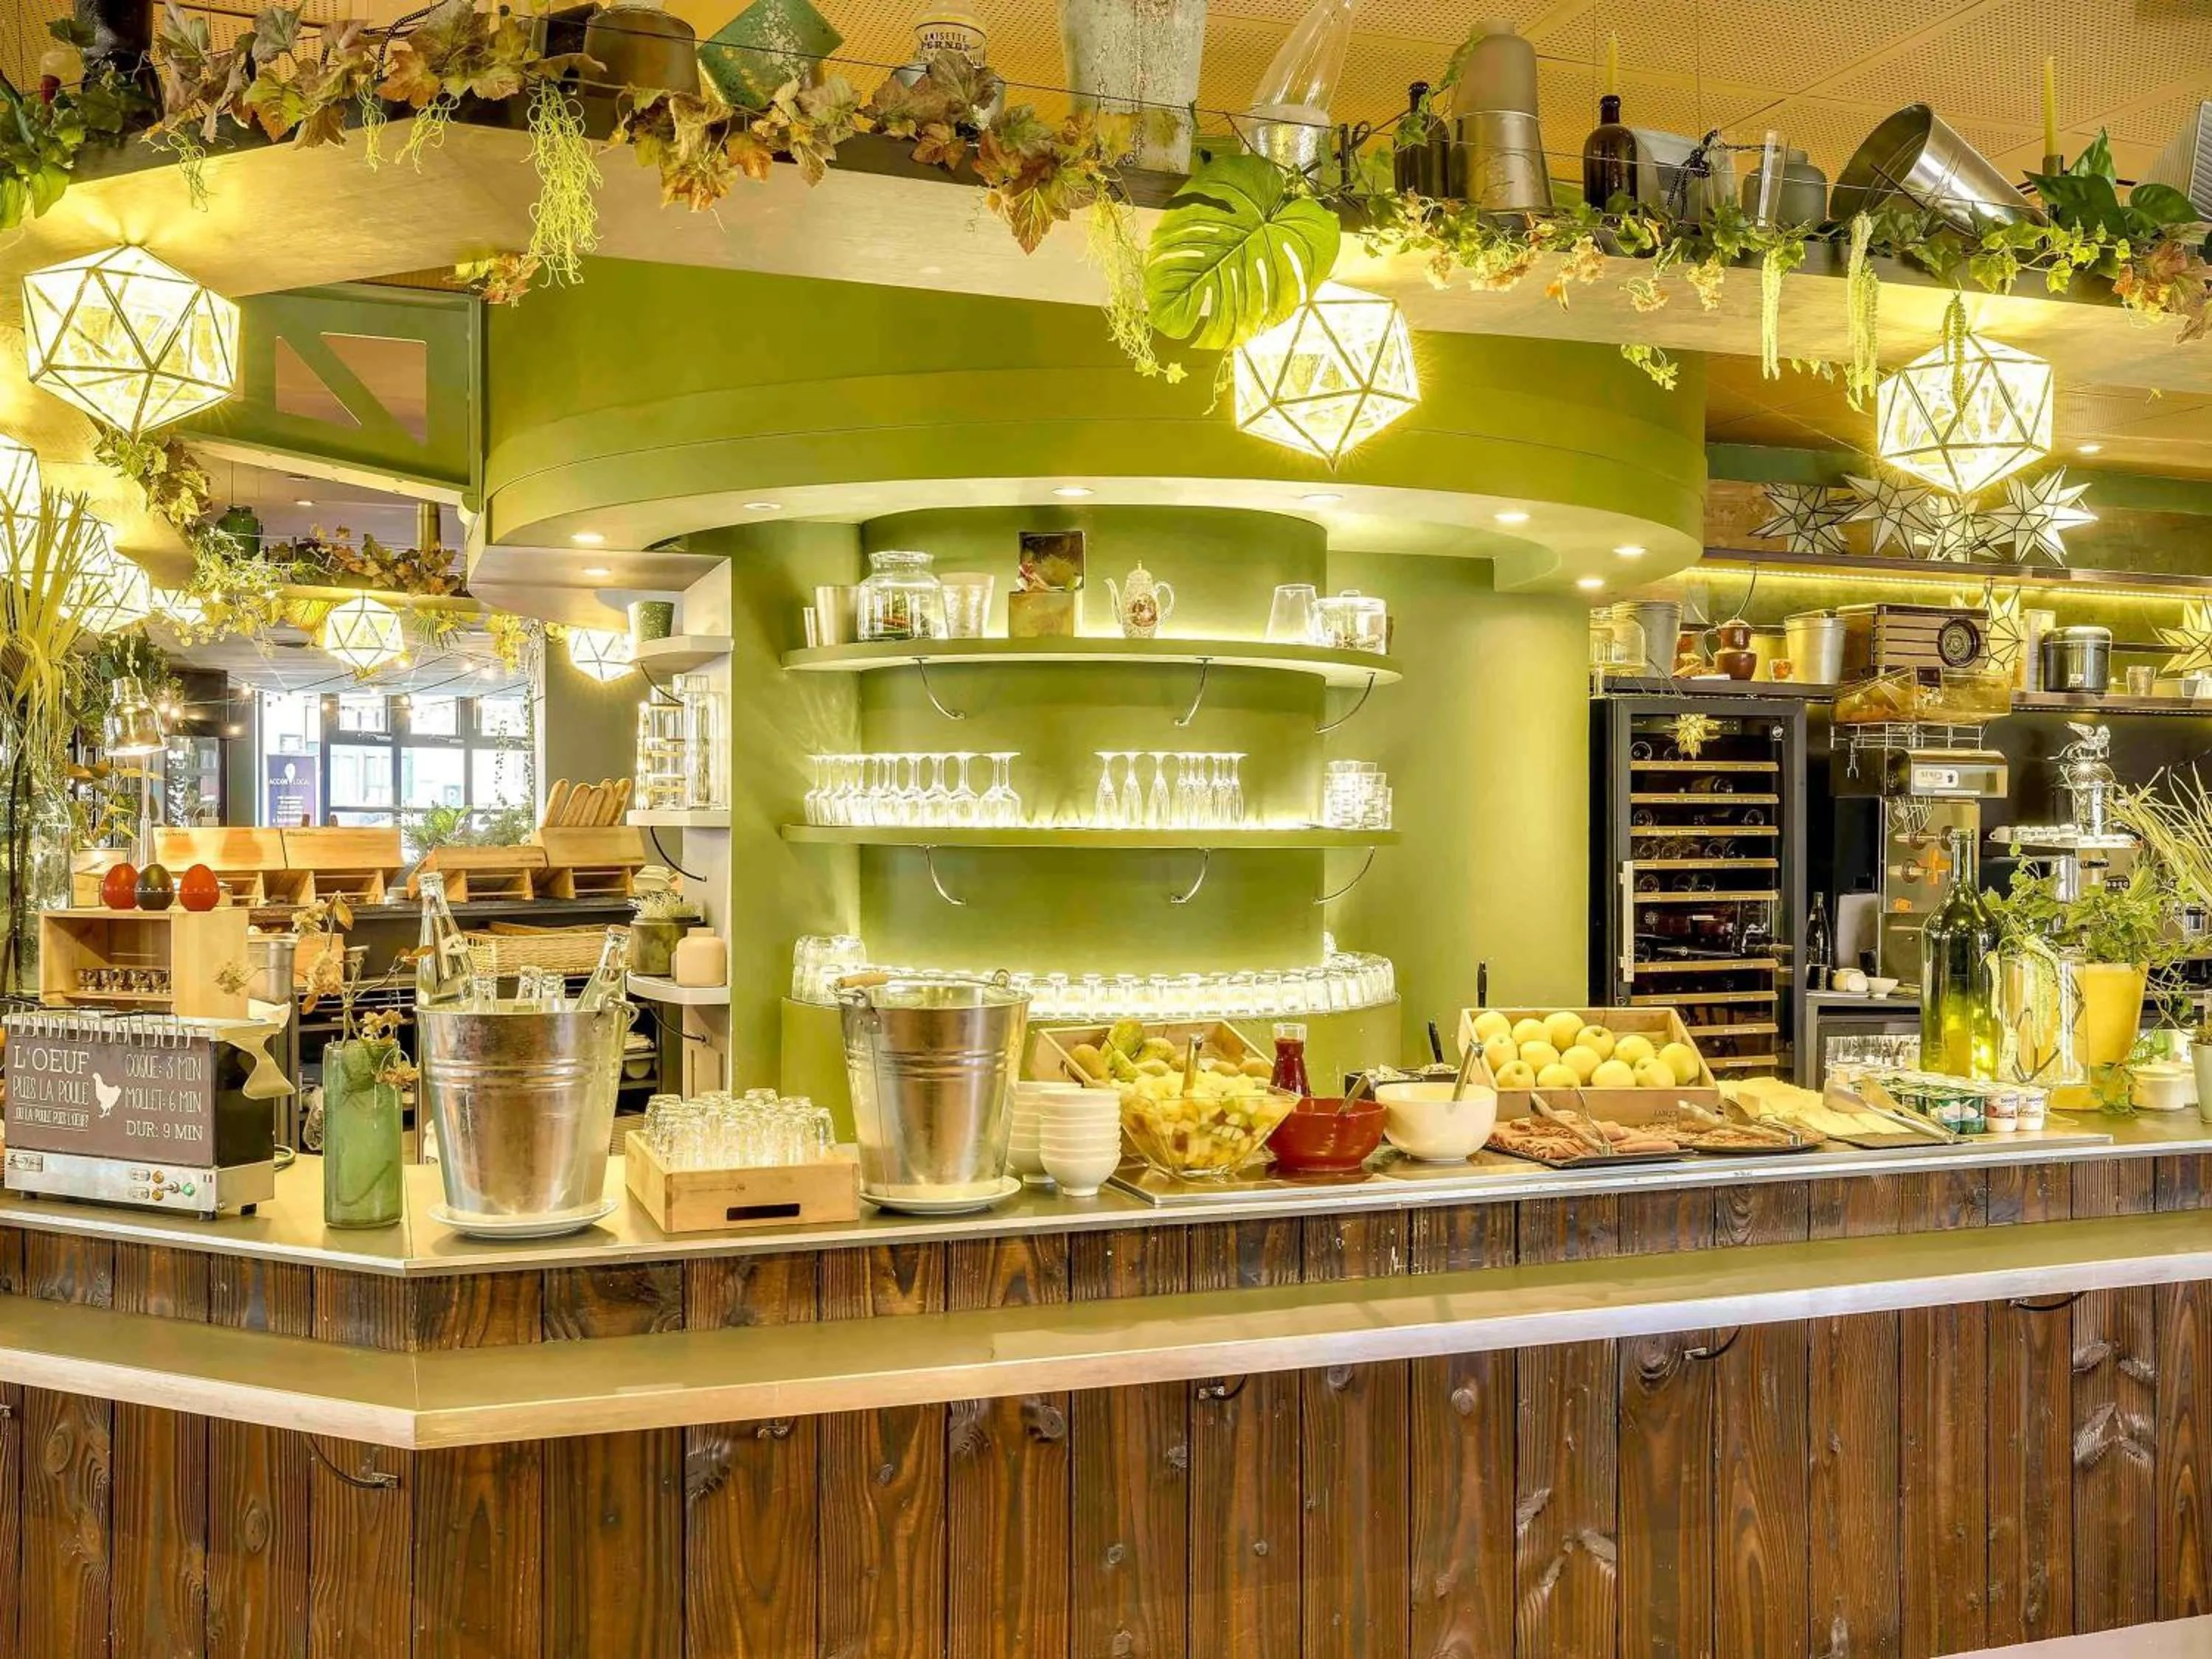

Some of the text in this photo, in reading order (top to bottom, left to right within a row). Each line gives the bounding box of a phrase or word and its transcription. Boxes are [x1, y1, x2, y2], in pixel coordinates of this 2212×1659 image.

[14, 1045, 89, 1074] L'OEUF
[166, 1056, 173, 1079] 3
[178, 1057, 201, 1082] MIN
[13, 1075, 89, 1105] PUIS LA POULE
[169, 1091, 176, 1112] 6
[179, 1091, 201, 1113] MIN
[126, 1120, 203, 1141] DUR: 9 MIN
